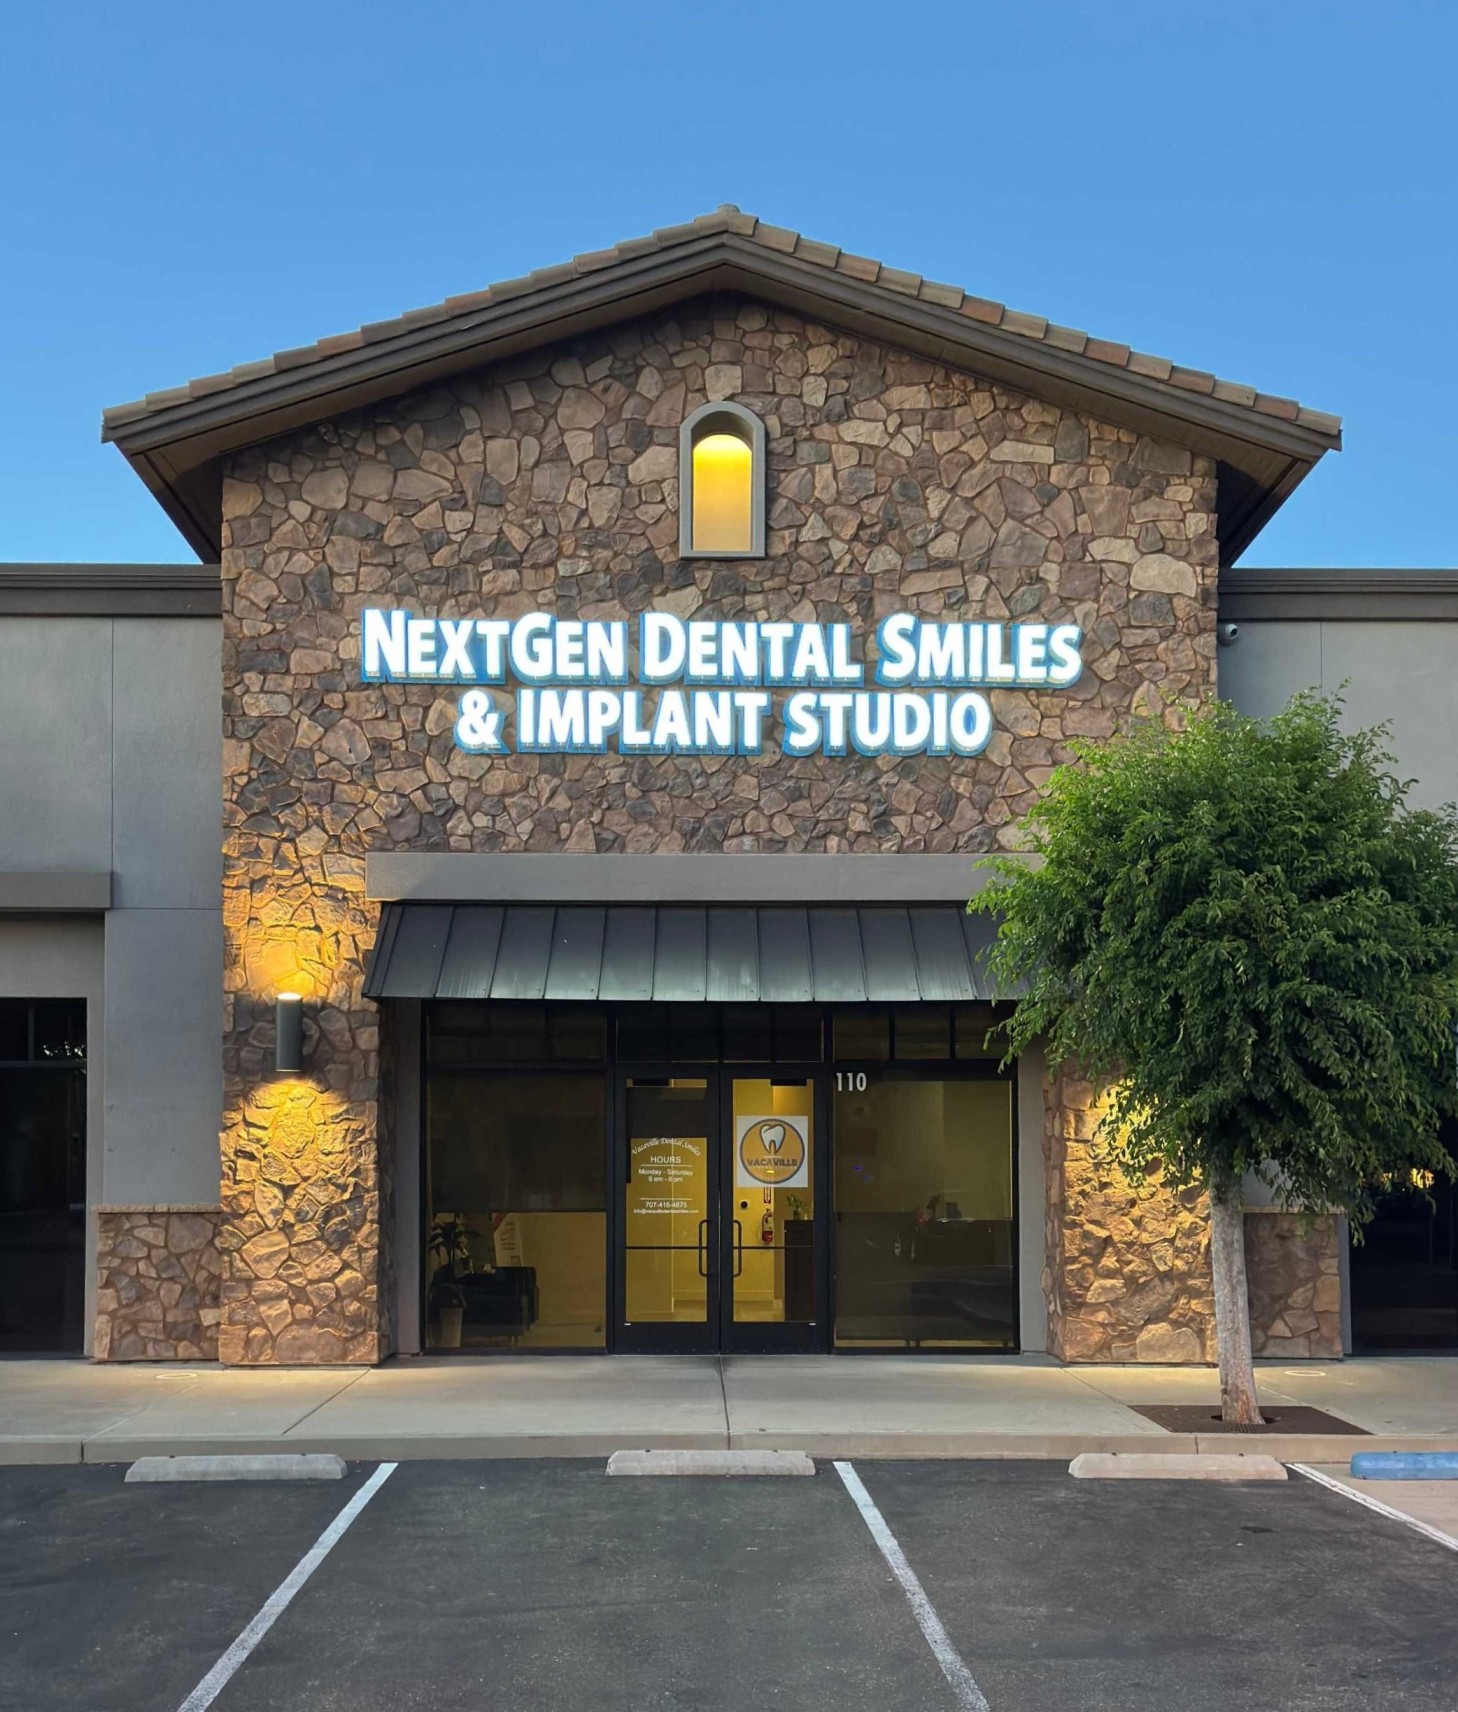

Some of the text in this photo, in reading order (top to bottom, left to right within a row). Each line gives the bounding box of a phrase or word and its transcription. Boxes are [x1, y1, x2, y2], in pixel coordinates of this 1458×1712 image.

[642, 612, 863, 682] DENTAL
[879, 613, 1082, 684] SMILES
[456, 690, 991, 752] & IMPLANT STUDIO
[836, 1072, 867, 1091] 110
[650, 1156, 682, 1164] HOURS
[747, 1159, 798, 1167] VACAVILLE
[667, 1168, 693, 1176] Saturday
